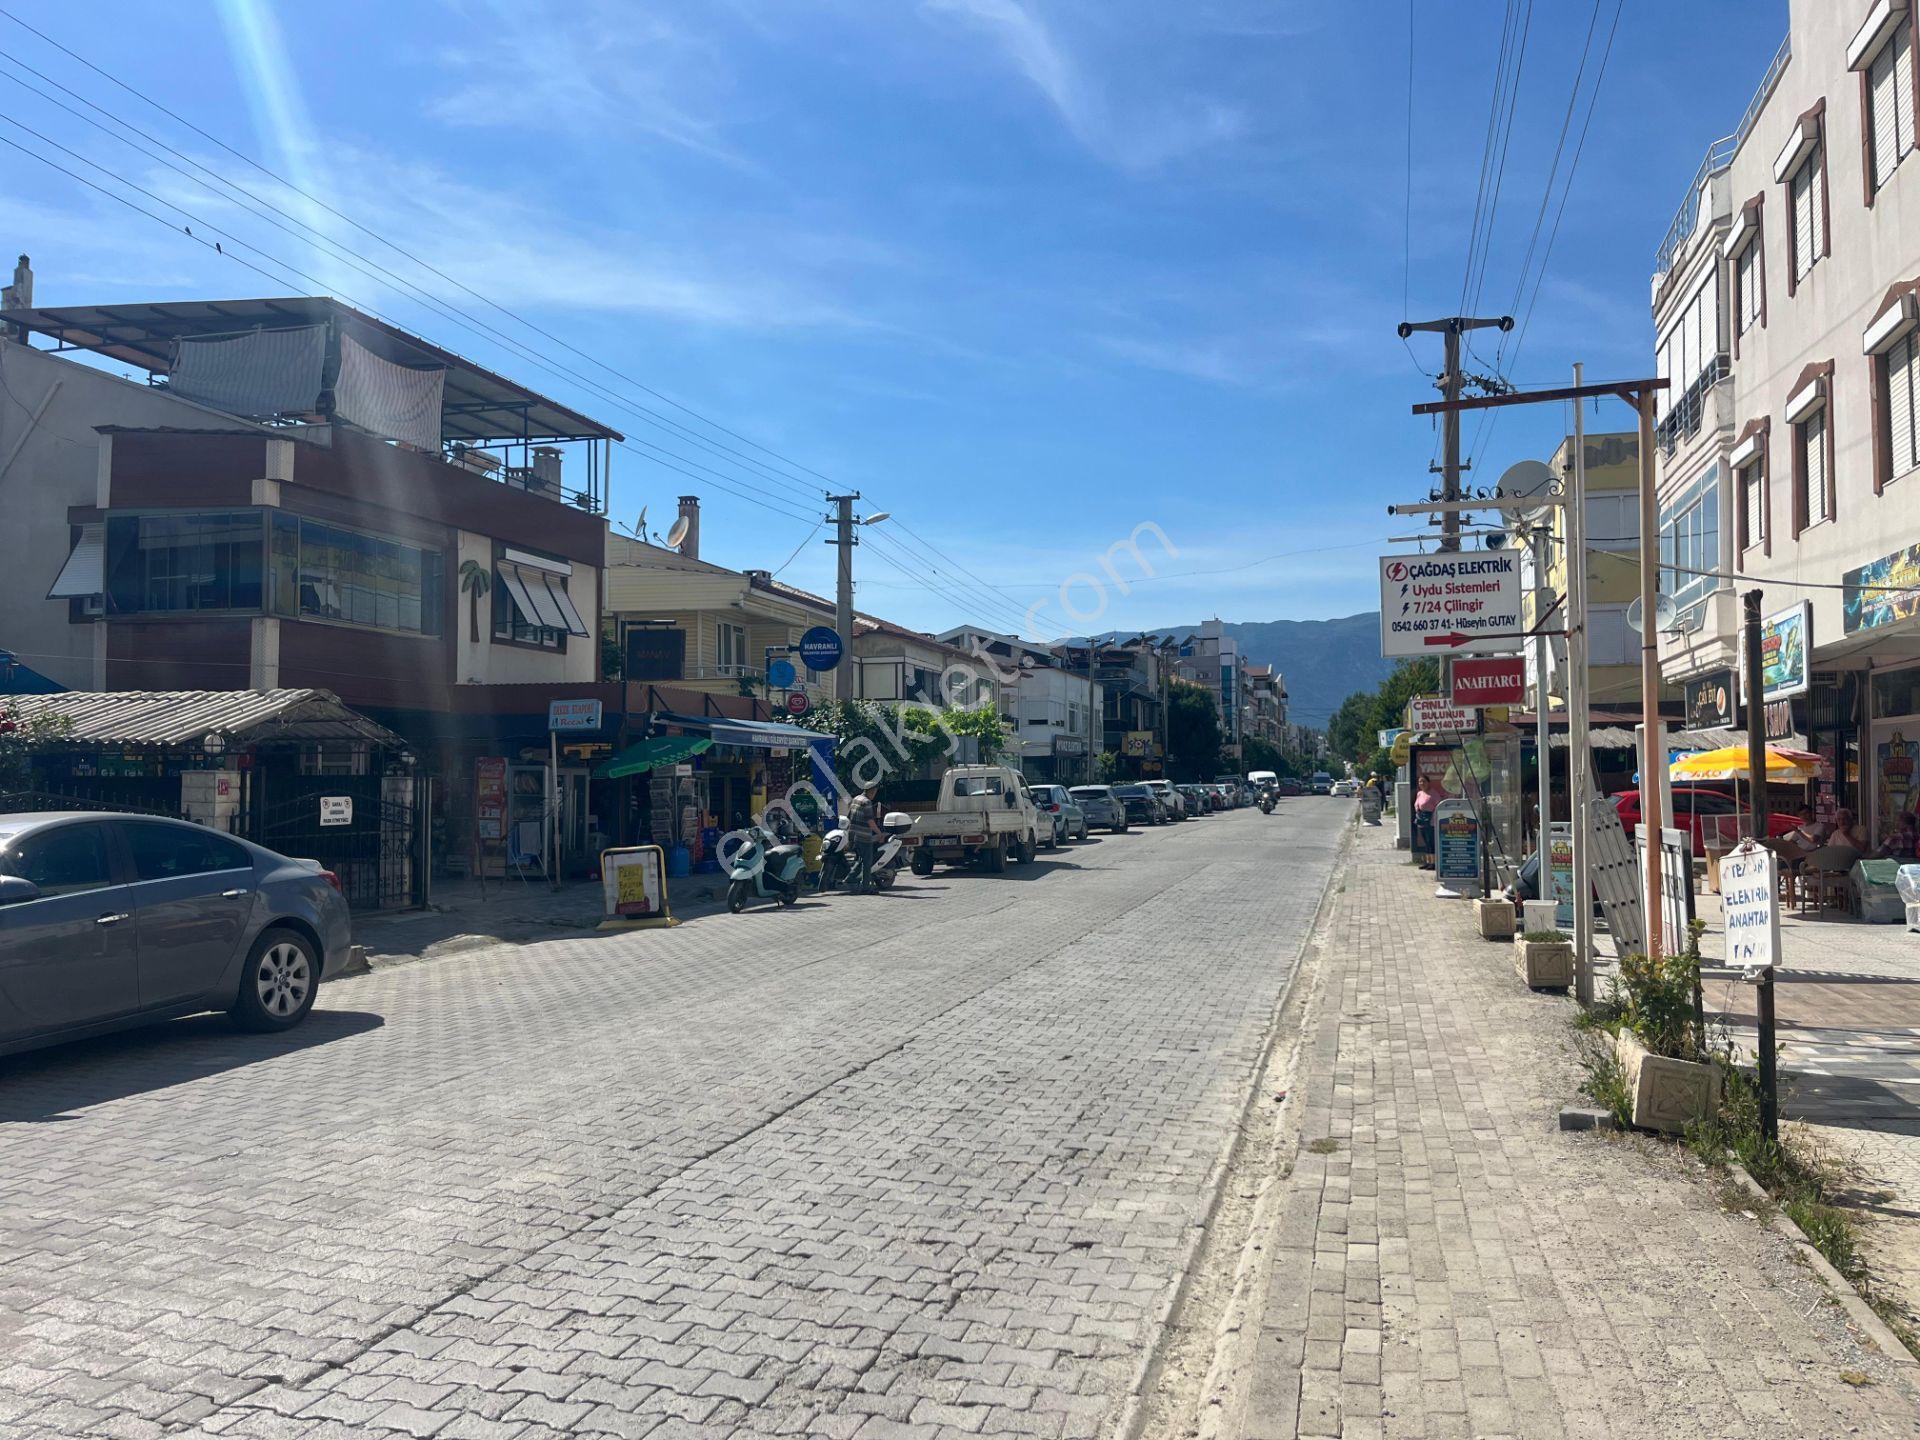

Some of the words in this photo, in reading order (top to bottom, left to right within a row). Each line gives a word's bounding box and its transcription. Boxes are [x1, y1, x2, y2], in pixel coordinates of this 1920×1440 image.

[1409, 561, 1455, 580] ÇAĞDAŞ
[1458, 556, 1512, 575] ELEKTRİK
[1412, 583, 1442, 598] Uydu
[1445, 579, 1500, 594] Sistemleri
[1413, 601, 1441, 615] 7/24
[1444, 598, 1484, 614] Çilingir
[1391, 621, 1411, 632] 0542
[1413, 620, 1428, 631] 660
[1429, 619, 1439, 631] 37
[1456, 617, 1487, 630] Hüseyin
[1455, 675, 1521, 690] ANAHTARCI
[1421, 711, 1465, 720] BULUNUR
